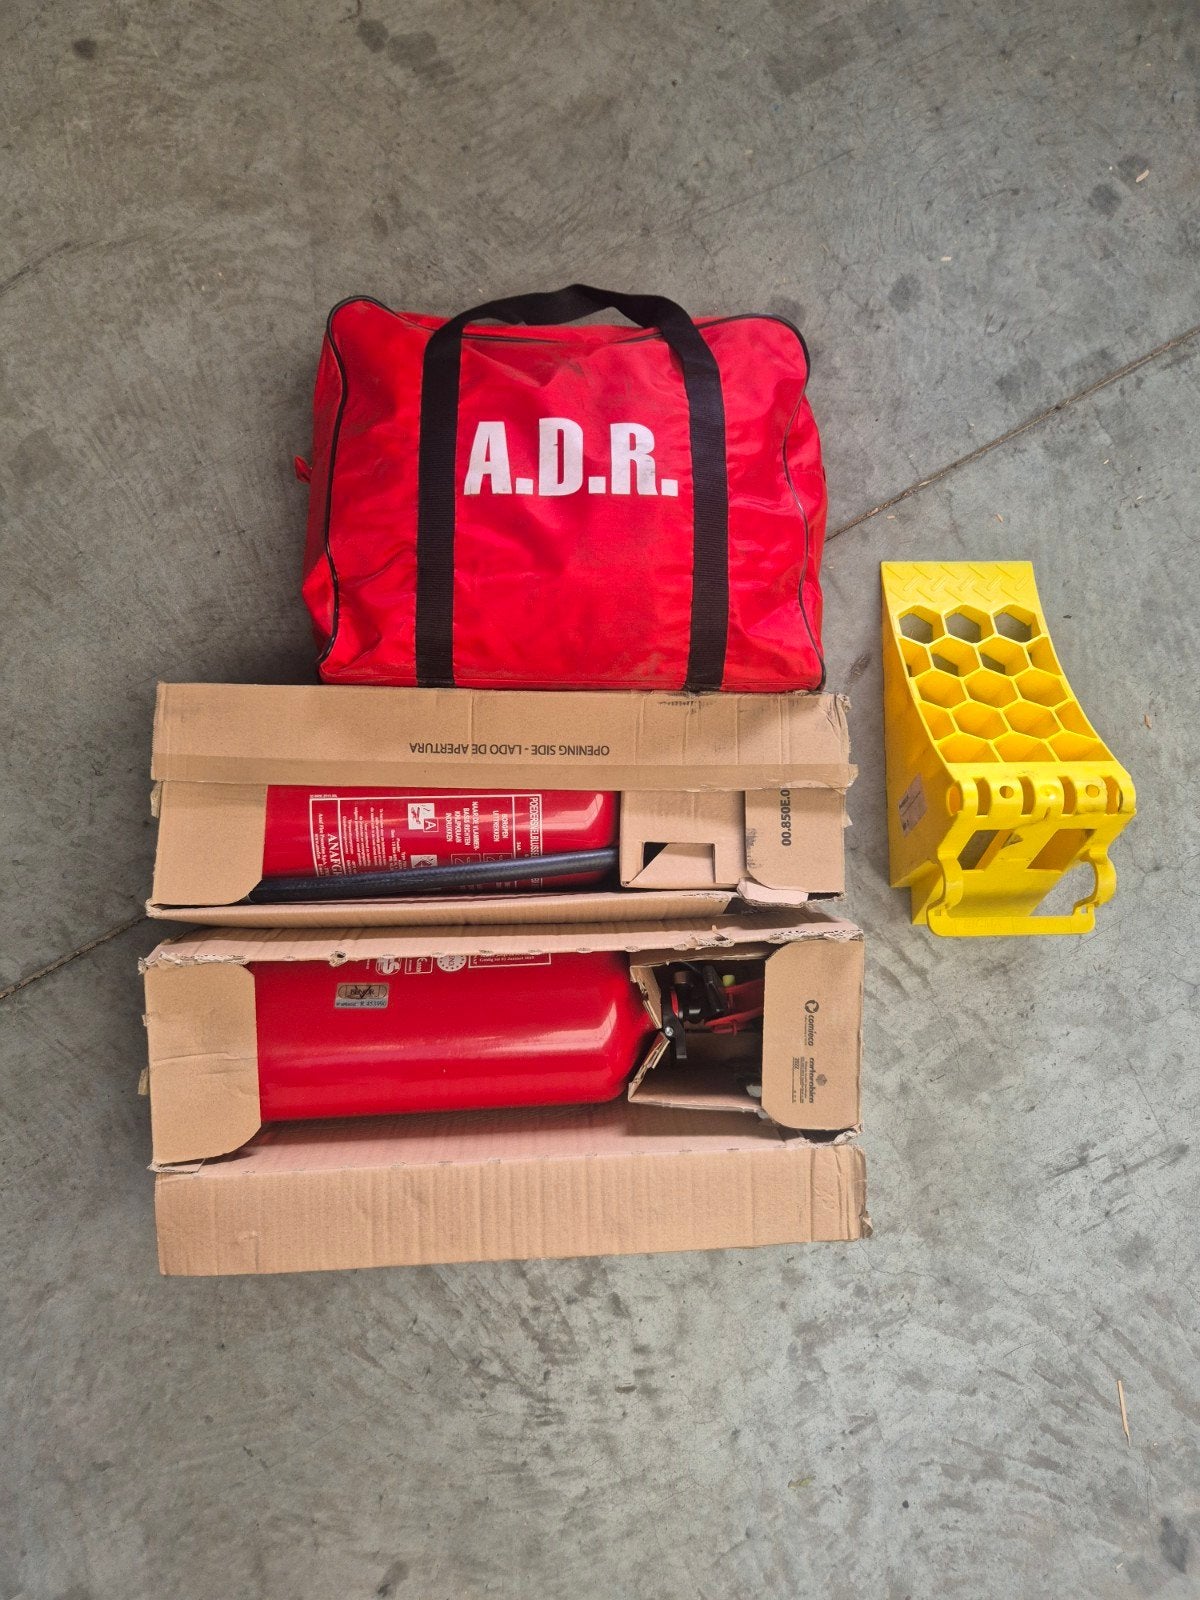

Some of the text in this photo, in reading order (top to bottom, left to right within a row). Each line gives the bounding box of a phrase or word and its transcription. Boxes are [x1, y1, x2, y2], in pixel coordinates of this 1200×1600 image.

[462, 416, 680, 498] A.D.R.
[408, 742, 470, 755] APERTURA
[471, 743, 487, 755] DE
[489, 744, 522, 756] LADO
[531, 744, 557, 756] SIDE
[559, 745, 610, 757] OPENING
[425, 820, 437, 831] A
[445, 812, 453, 842] INDRUKKEN
[463, 807, 471, 846] BASIS RICHTEN
[492, 810, 501, 842] UITTREKKEN
[501, 813, 509, 839] BORGPEN
[529, 797, 540, 859] POEDERSNELBLUSSE
[807, 1014, 817, 1047] comieco
